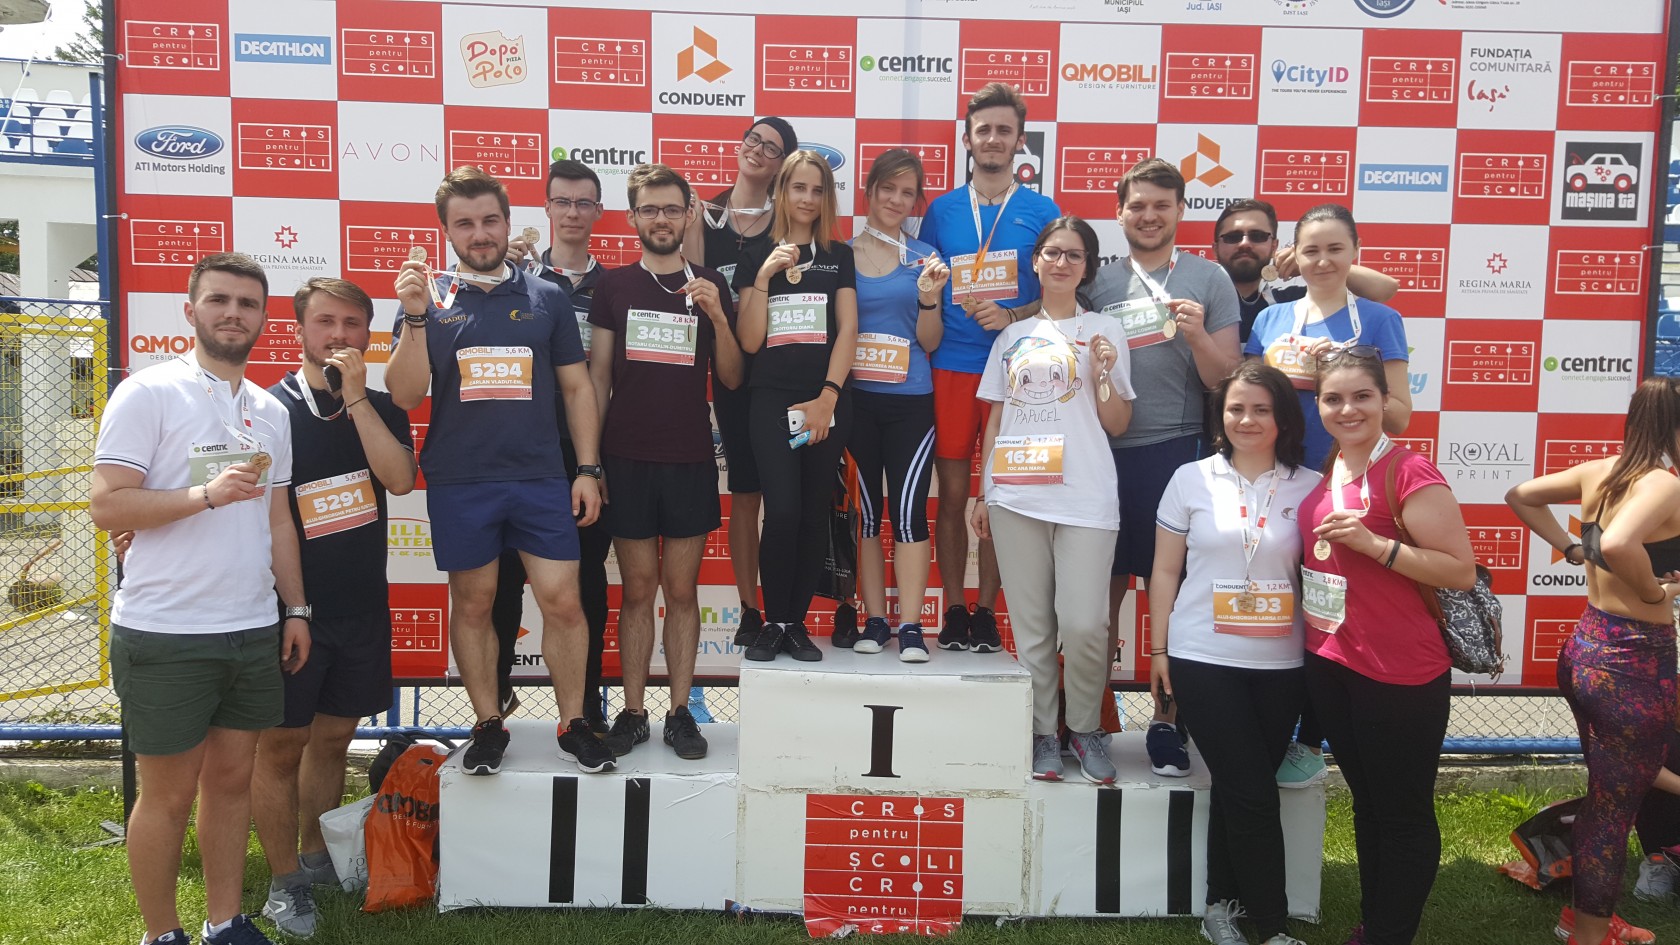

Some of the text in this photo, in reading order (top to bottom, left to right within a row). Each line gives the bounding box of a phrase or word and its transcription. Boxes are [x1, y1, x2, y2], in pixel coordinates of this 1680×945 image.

[152, 42, 187, 50] pentru
[240, 41, 325, 57] DECATHLON
[369, 49, 402, 57] pentru
[581, 57, 614, 66] pentru
[878, 55, 952, 73] centric
[789, 64, 821, 72] pentru
[988, 68, 1019, 76] pentru
[1061, 62, 1156, 82] QMOBILI
[1470, 62, 1552, 73] COMUNITARĂ
[1191, 72, 1223, 80] pentru
[1287, 65, 1349, 87] CityID
[1392, 76, 1424, 84] pentru
[1592, 80, 1624, 88] pentru
[658, 92, 746, 107] CONDUENT
[152, 130, 208, 155] Ford
[265, 143, 299, 151] pentru
[342, 142, 438, 162] AVON
[477, 150, 510, 159] pentru
[570, 147, 646, 165] centric
[152, 164, 186, 172] Motors
[188, 164, 225, 175] Holding
[1087, 166, 1118, 174] pentru
[1286, 168, 1318, 176] pentru
[1364, 171, 1442, 185] DECATHLON
[1618, 193, 1636, 208] ta
[158, 239, 192, 247] pentru
[374, 245, 406, 254] pentru
[292, 256, 327, 264] MARIA
[1382, 266, 1414, 274] pentru
[1581, 268, 1612, 277] pentru
[1459, 280, 1496, 288] REGINA
[771, 308, 816, 325] 3454
[1122, 309, 1157, 329] 545
[637, 326, 685, 344] 3435
[856, 347, 898, 362] 5317
[1561, 355, 1632, 372] centric
[469, 362, 523, 378] 5294
[1005, 448, 1049, 464] 1624
[1448, 442, 1523, 467] ROYAL
[1457, 470, 1511, 479] PRINT
[313, 488, 364, 513] 5291
[1332, 579, 1343, 587] KM
[1227, 597, 1281, 613] 193
[861, 705, 903, 779] I
[850, 828, 908, 840] pentru
[848, 905, 906, 915] pentru
